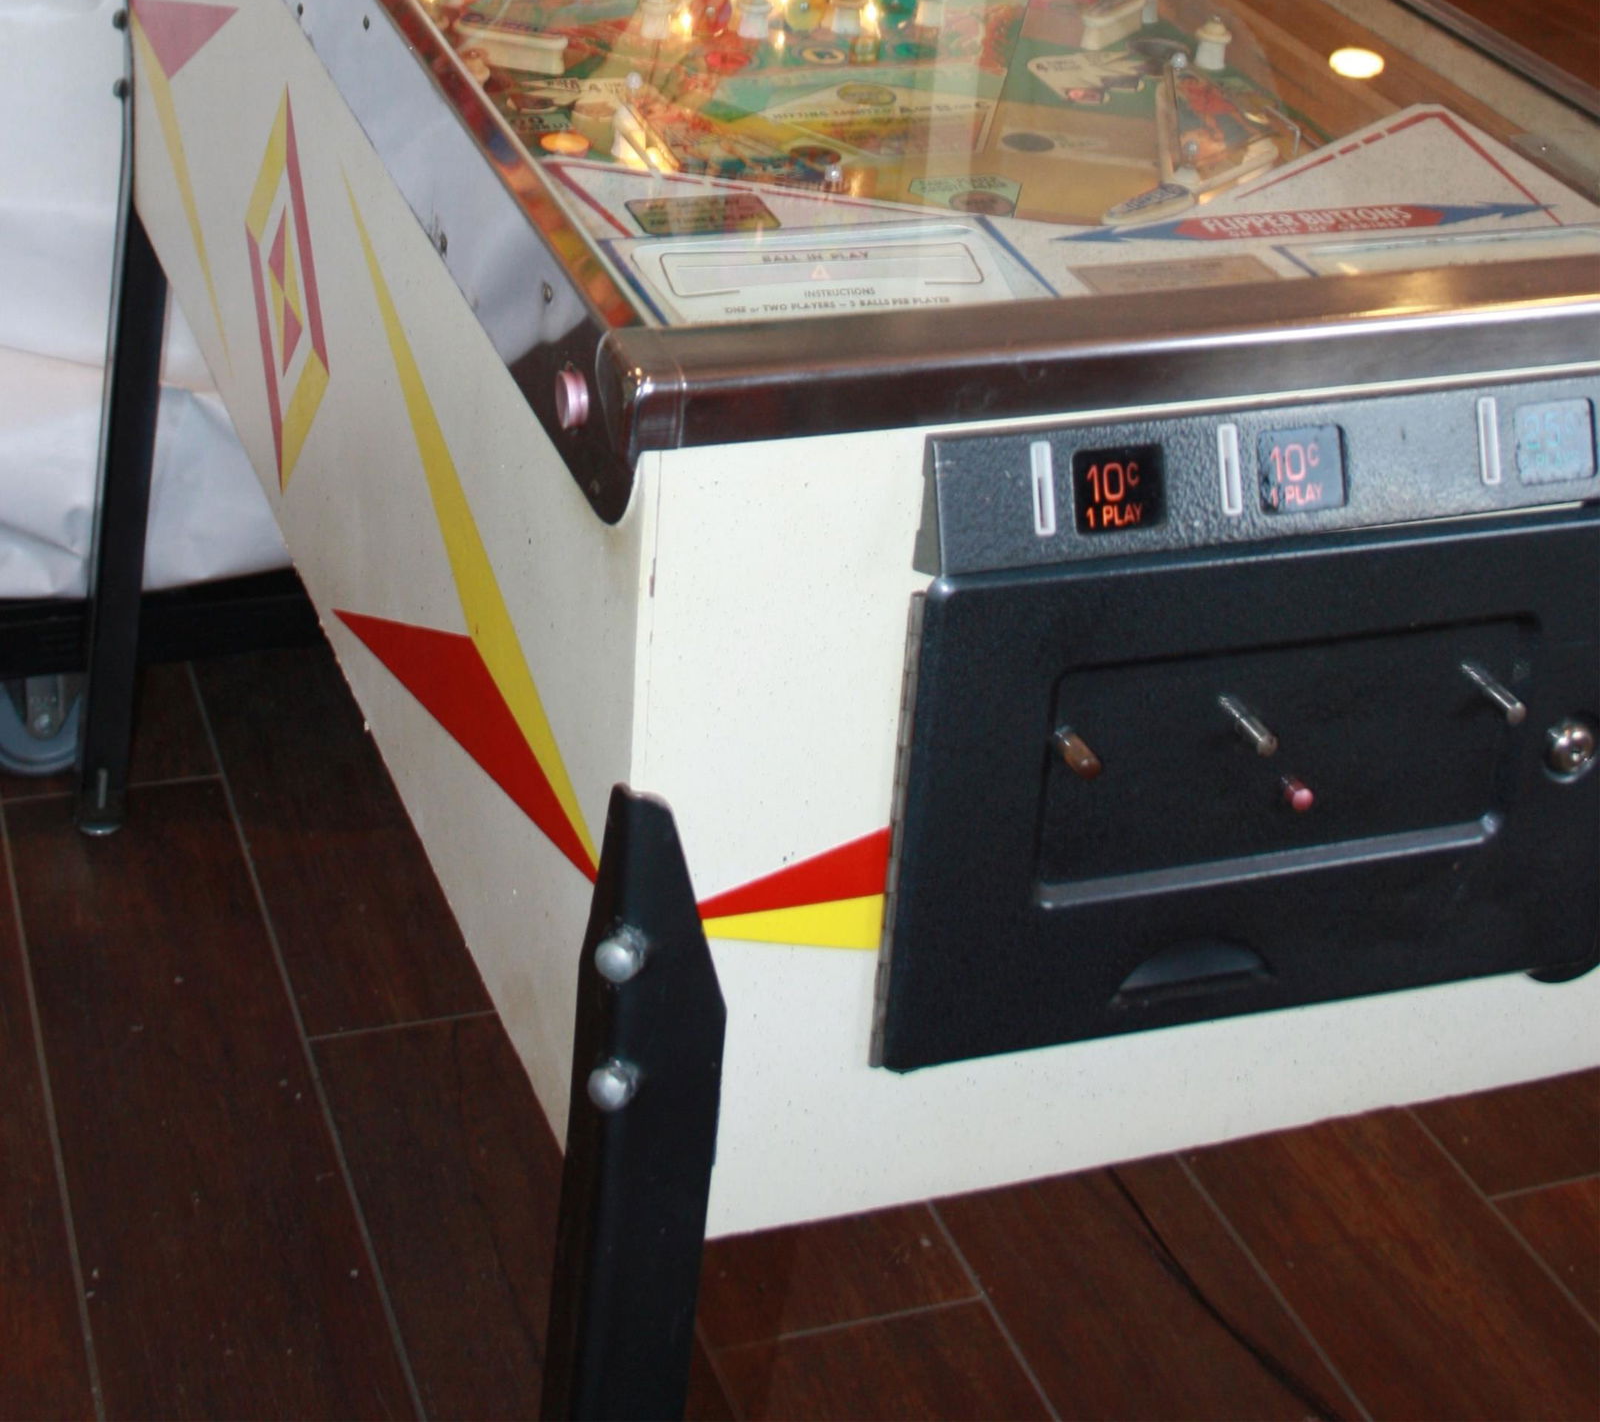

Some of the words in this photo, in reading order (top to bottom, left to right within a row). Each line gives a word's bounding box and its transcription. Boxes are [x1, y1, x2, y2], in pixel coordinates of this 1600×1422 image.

[1202, 213, 1300, 233] FLIPPER
[1297, 206, 1412, 227] BUTTONS
[831, 250, 869, 260] PLAY
[804, 286, 876, 299] INSTRUCTIONS
[762, 303, 788, 313] TWO
[790, 300, 835, 311] PLAYERS
[1285, 484, 1323, 506] PLAY
[1085, 508, 1095, 528] 1
[1102, 503, 1144, 527] PLAY
